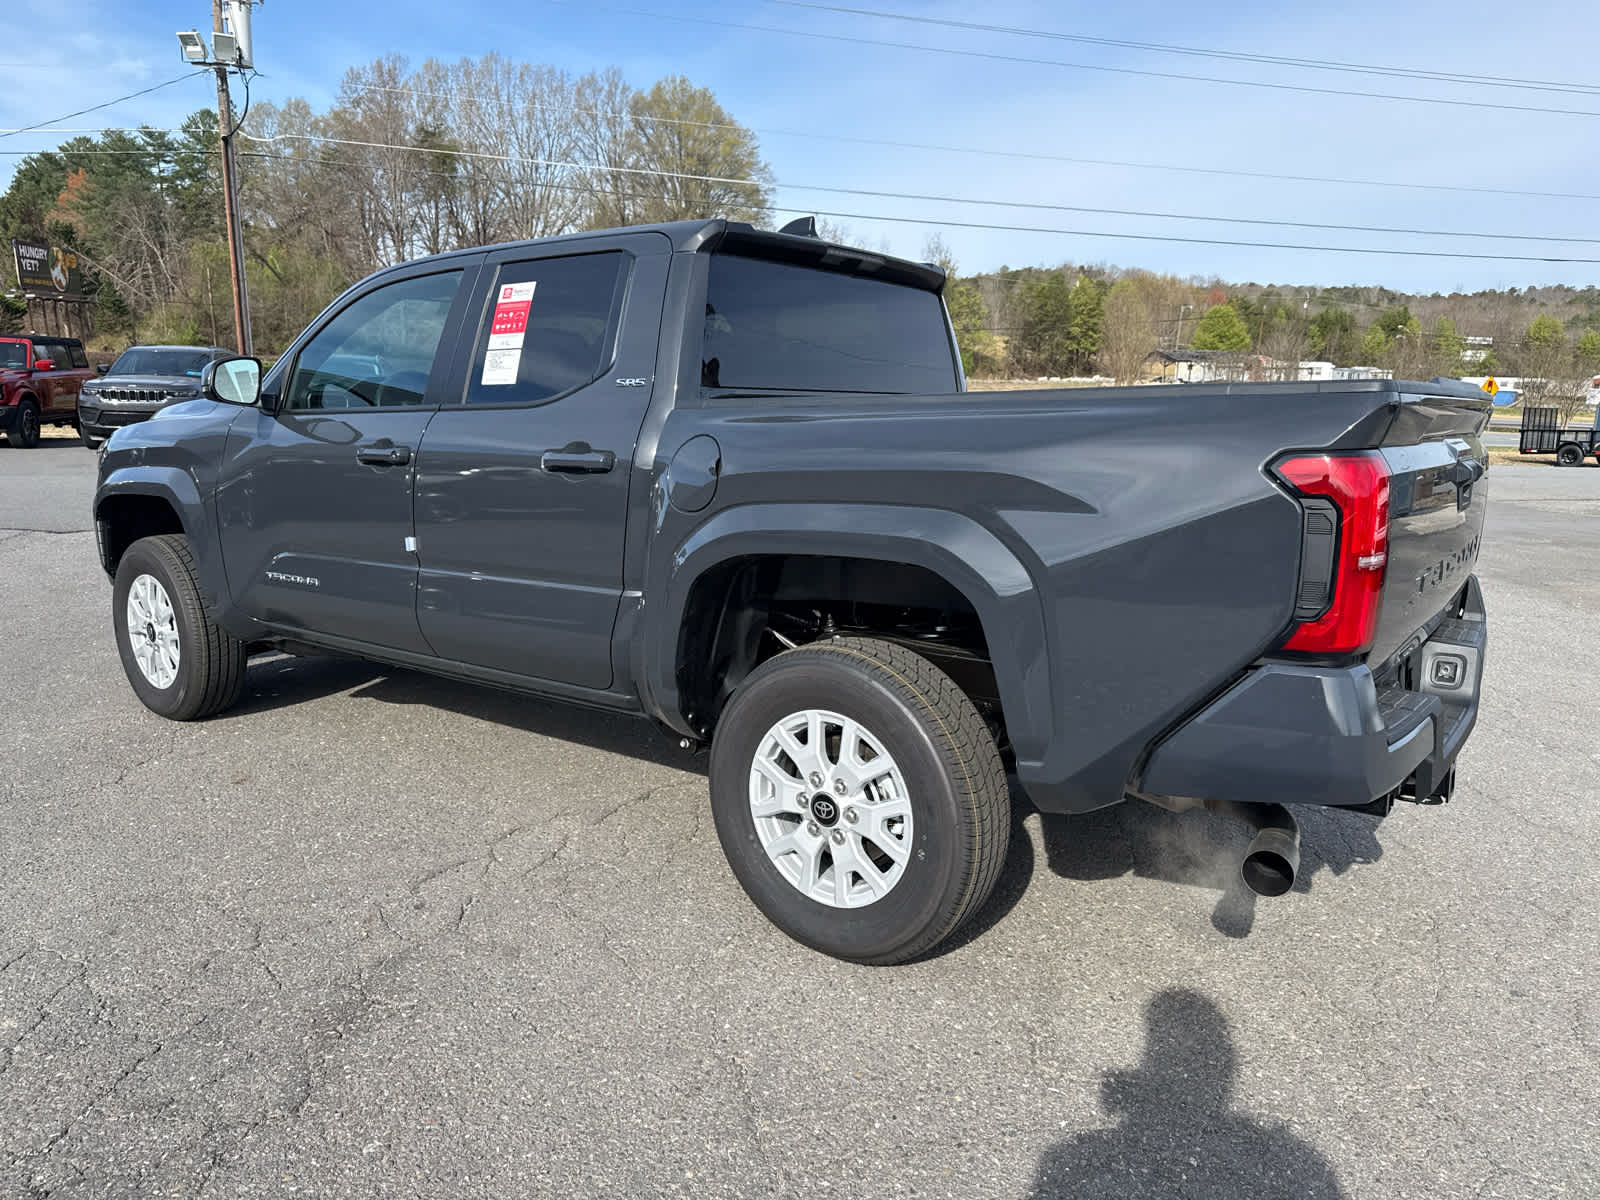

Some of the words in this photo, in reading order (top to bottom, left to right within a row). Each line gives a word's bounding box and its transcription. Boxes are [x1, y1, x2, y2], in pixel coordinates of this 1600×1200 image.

[18, 244, 48, 261] HUNGRY
[20, 257, 40, 272] YET?
[264, 571, 320, 587] TACOMA
